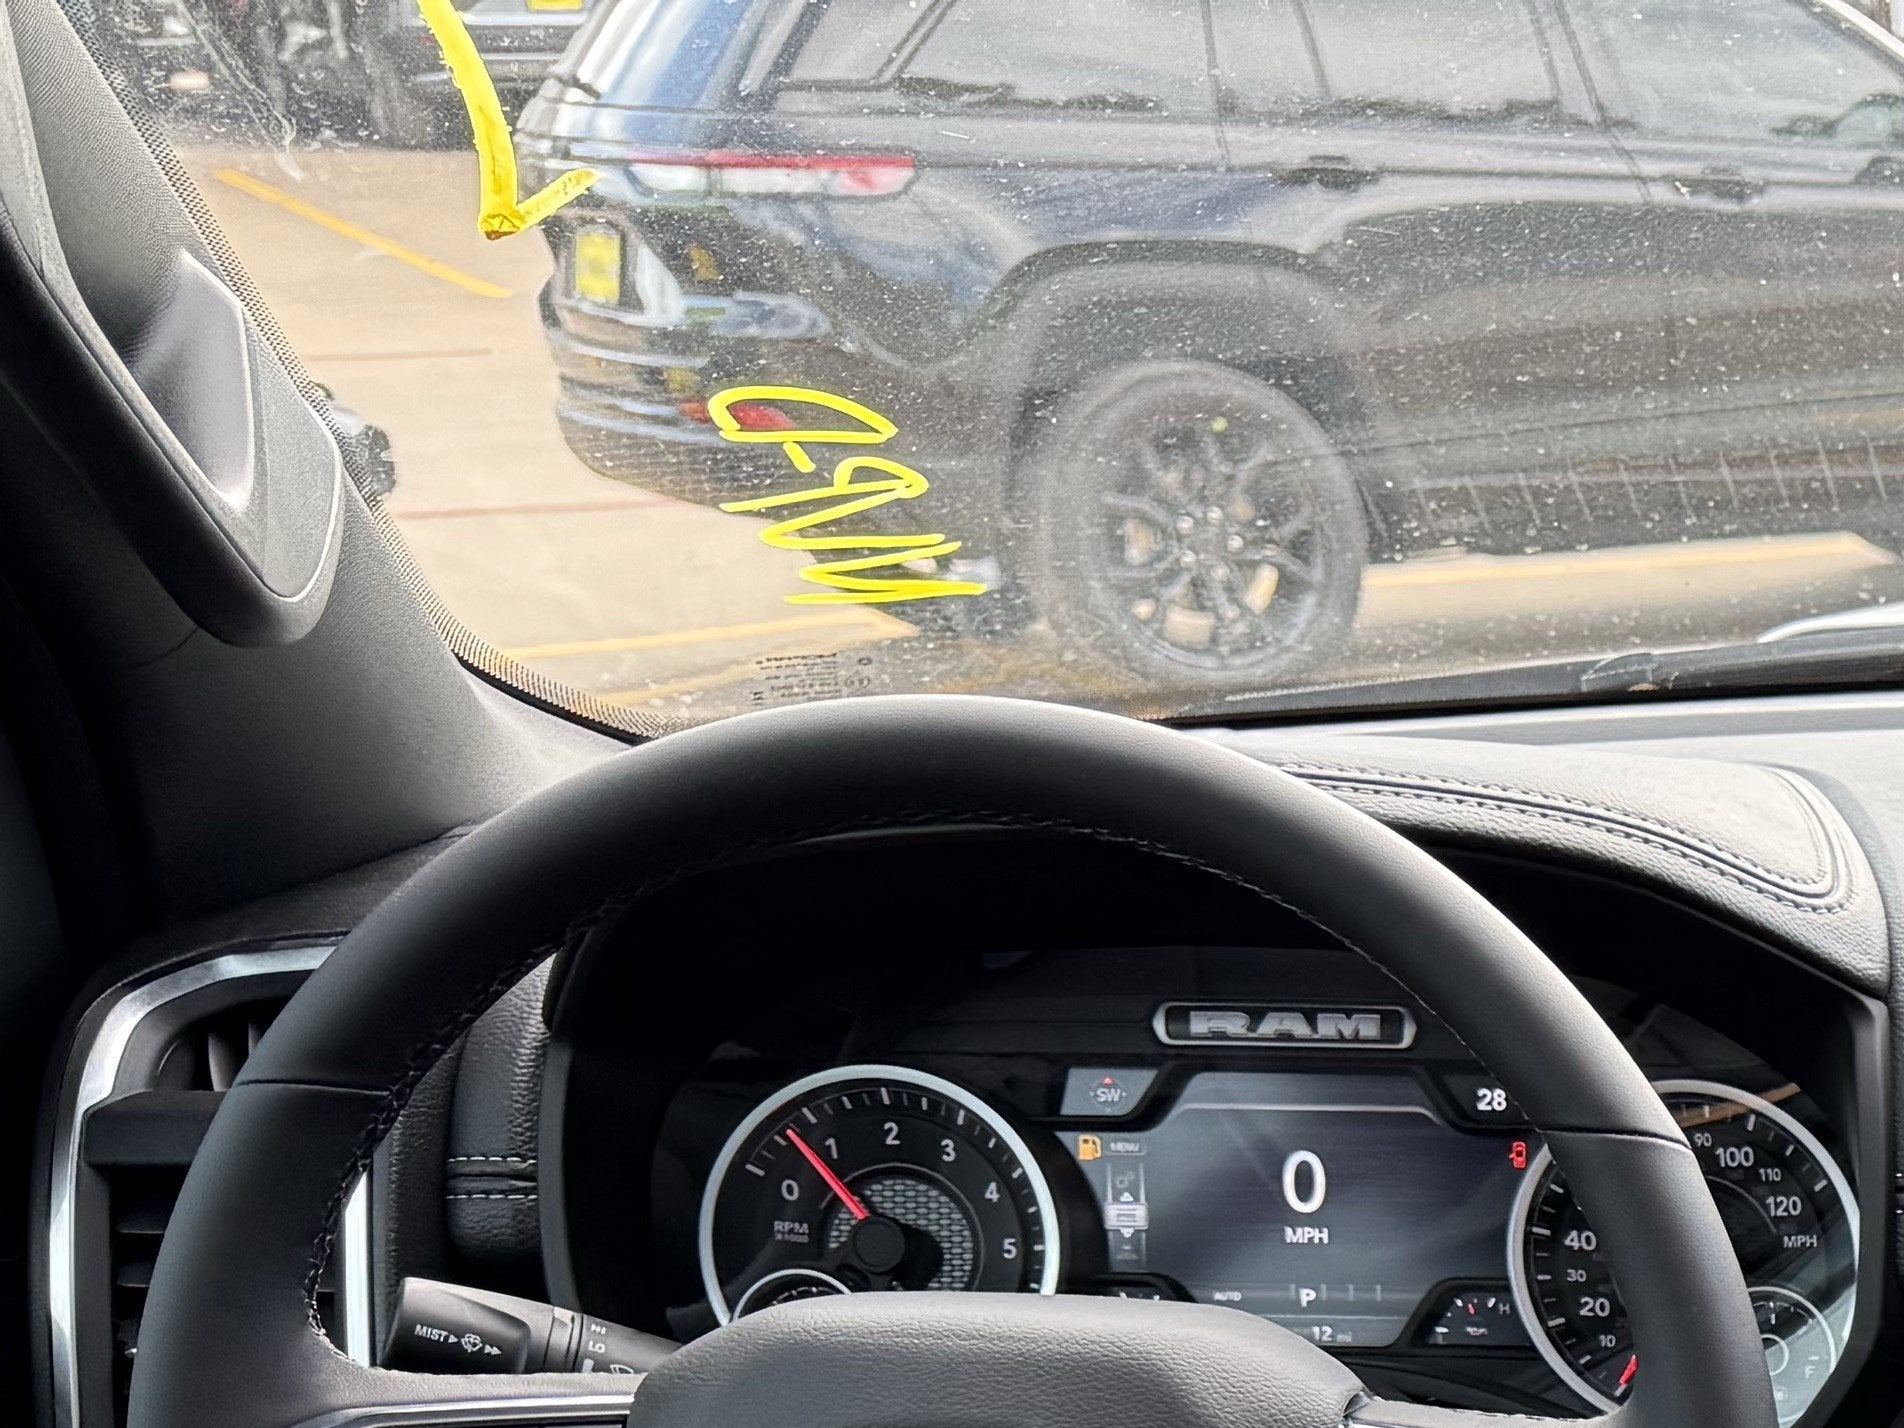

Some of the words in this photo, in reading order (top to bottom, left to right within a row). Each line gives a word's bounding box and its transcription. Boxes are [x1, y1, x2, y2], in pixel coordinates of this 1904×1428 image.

[1187, 1010, 1382, 1041] RAM
[1096, 1088, 1121, 1103] SW
[1475, 1086, 1507, 1113] 28
[882, 1121, 903, 1147] 2
[1692, 1132, 1713, 1148] 90
[825, 1137, 840, 1159] 1
[940, 1138, 958, 1162] 3
[1714, 1146, 1755, 1169] 100
[1281, 1149, 1327, 1214] 0
[1758, 1167, 1783, 1184] 110
[781, 1179, 800, 1202] 0
[982, 1180, 1002, 1204] 4
[1765, 1195, 1803, 1217] 120
[773, 1220, 810, 1234] RPM
[1283, 1226, 1330, 1245] MPH
[1001, 1238, 1018, 1260] 5
[1563, 1229, 1598, 1252] 40
[1782, 1234, 1818, 1249] MPH
[1565, 1269, 1587, 1283] 30
[1212, 1291, 1243, 1302] AUTO
[1298, 1288, 1317, 1308] P
[1579, 1296, 1611, 1318] 20
[415, 1323, 448, 1343] MIST
[1311, 1325, 1334, 1343] 12
[1598, 1334, 1617, 1348] 10
[587, 1339, 607, 1354] LO
[1804, 1364, 1817, 1380] F
